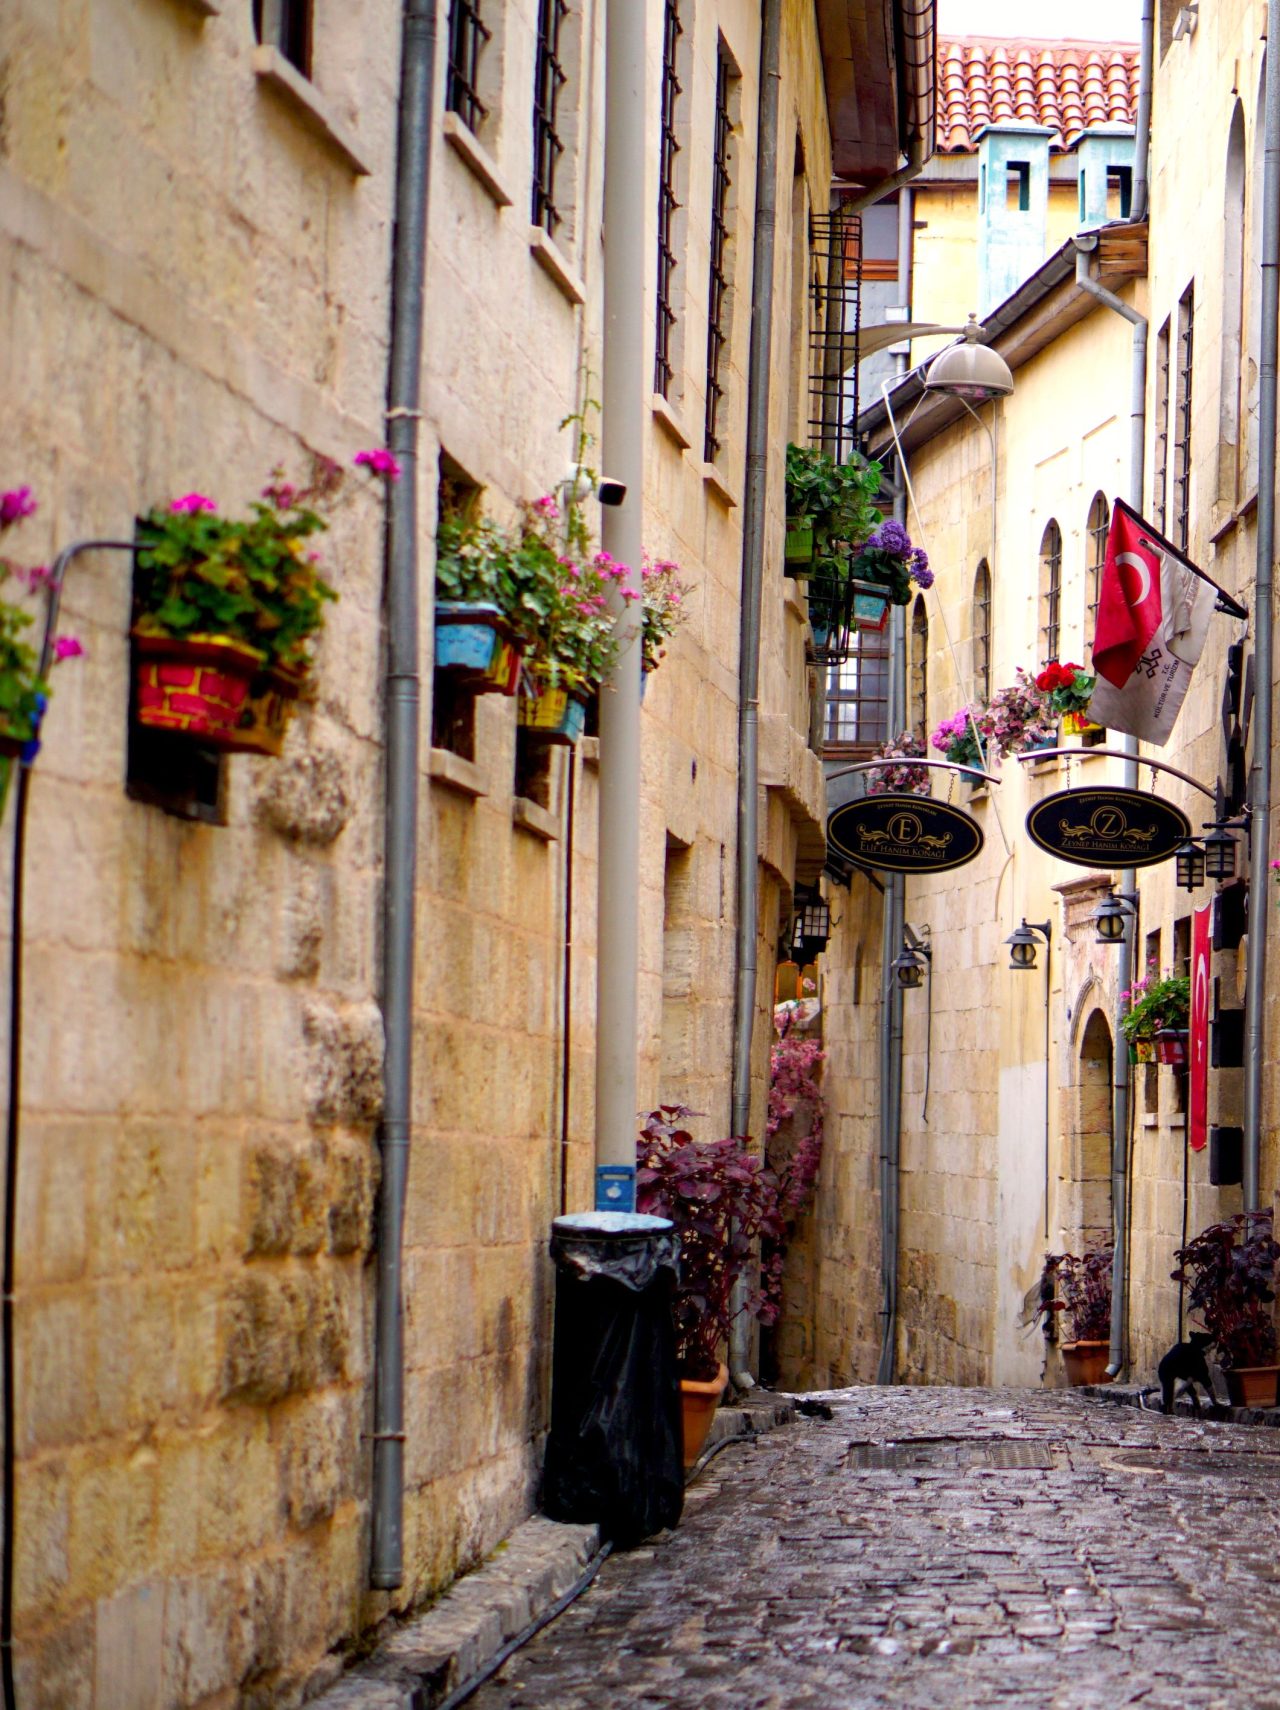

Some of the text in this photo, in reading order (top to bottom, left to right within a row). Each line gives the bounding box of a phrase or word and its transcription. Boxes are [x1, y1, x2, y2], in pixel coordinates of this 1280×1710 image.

[1163, 683, 1171, 692] VE
[898, 819, 912, 840] E
[1101, 813, 1117, 835] Z
[1061, 837, 1090, 848] ZEYNEP
